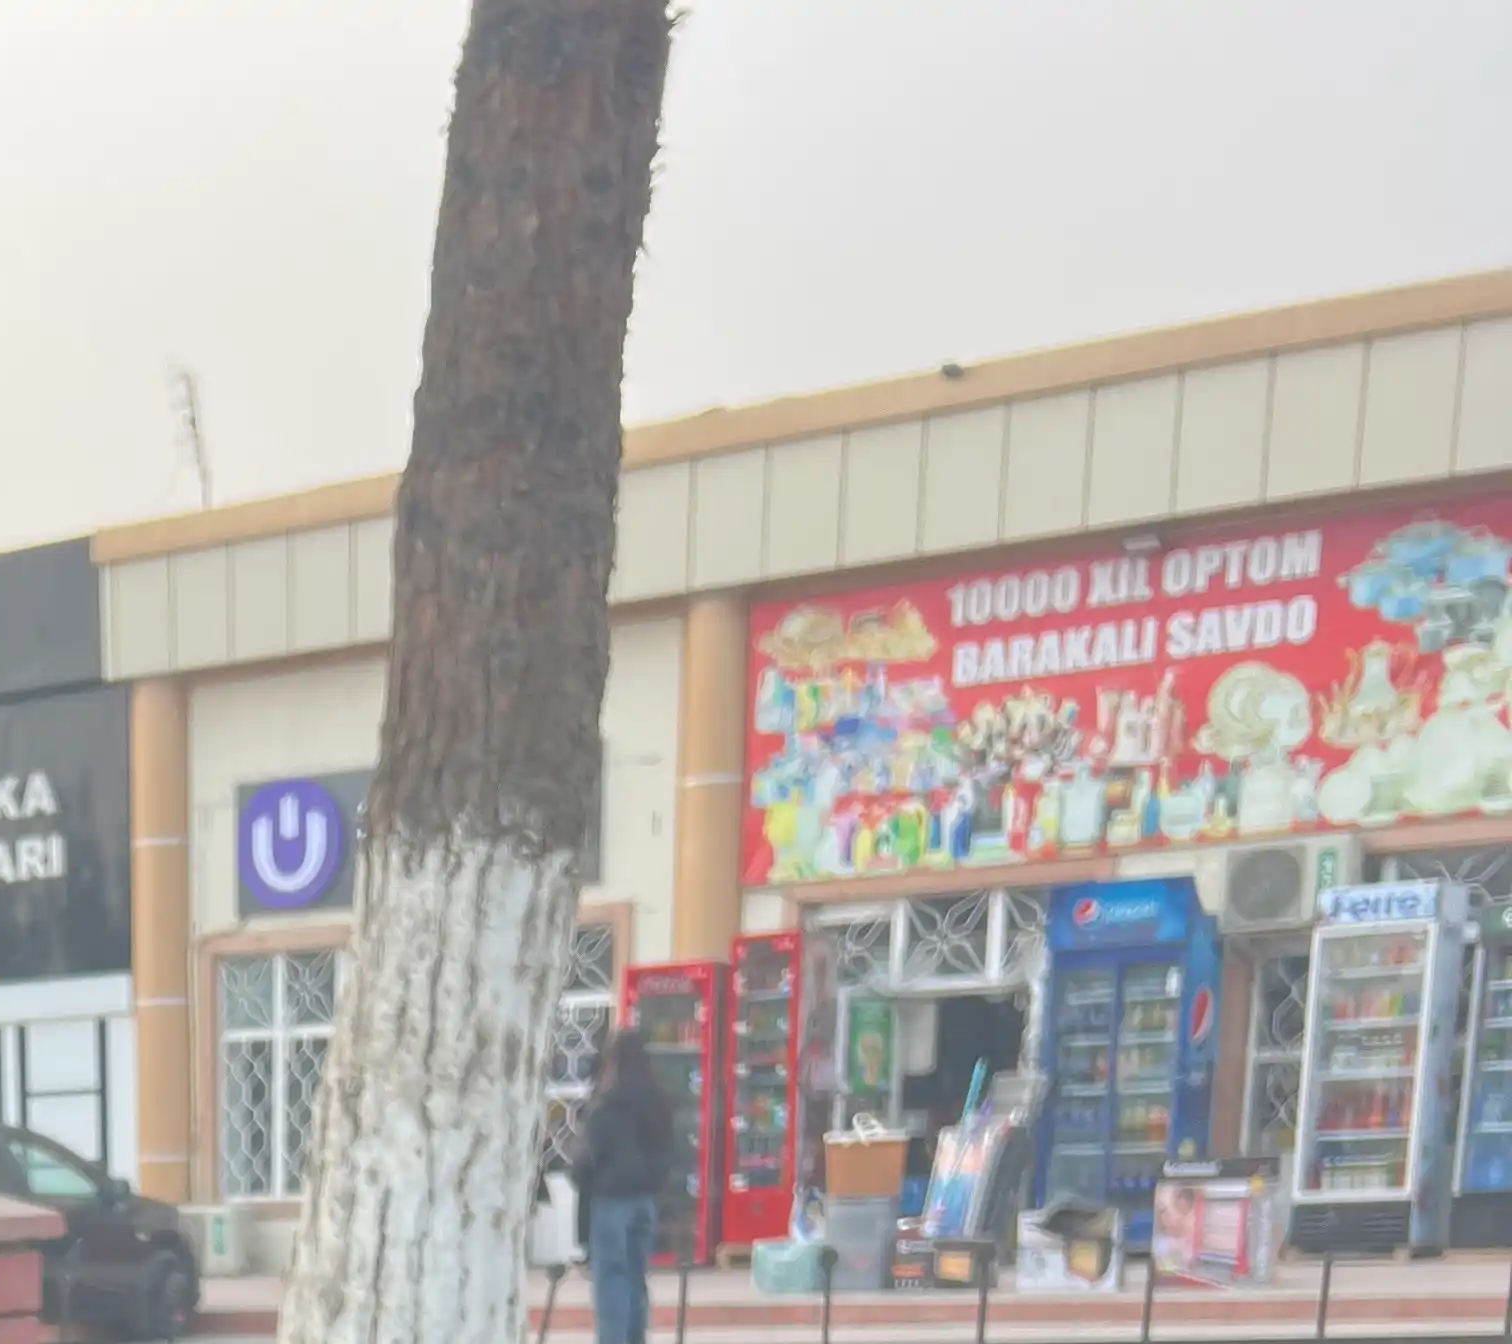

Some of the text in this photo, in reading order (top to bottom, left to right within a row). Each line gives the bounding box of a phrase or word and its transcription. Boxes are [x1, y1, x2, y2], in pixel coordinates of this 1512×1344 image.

[948, 529, 1322, 628] 10000 XIL OPTOM
[951, 594, 1318, 688] BARAKALI SAVDO
